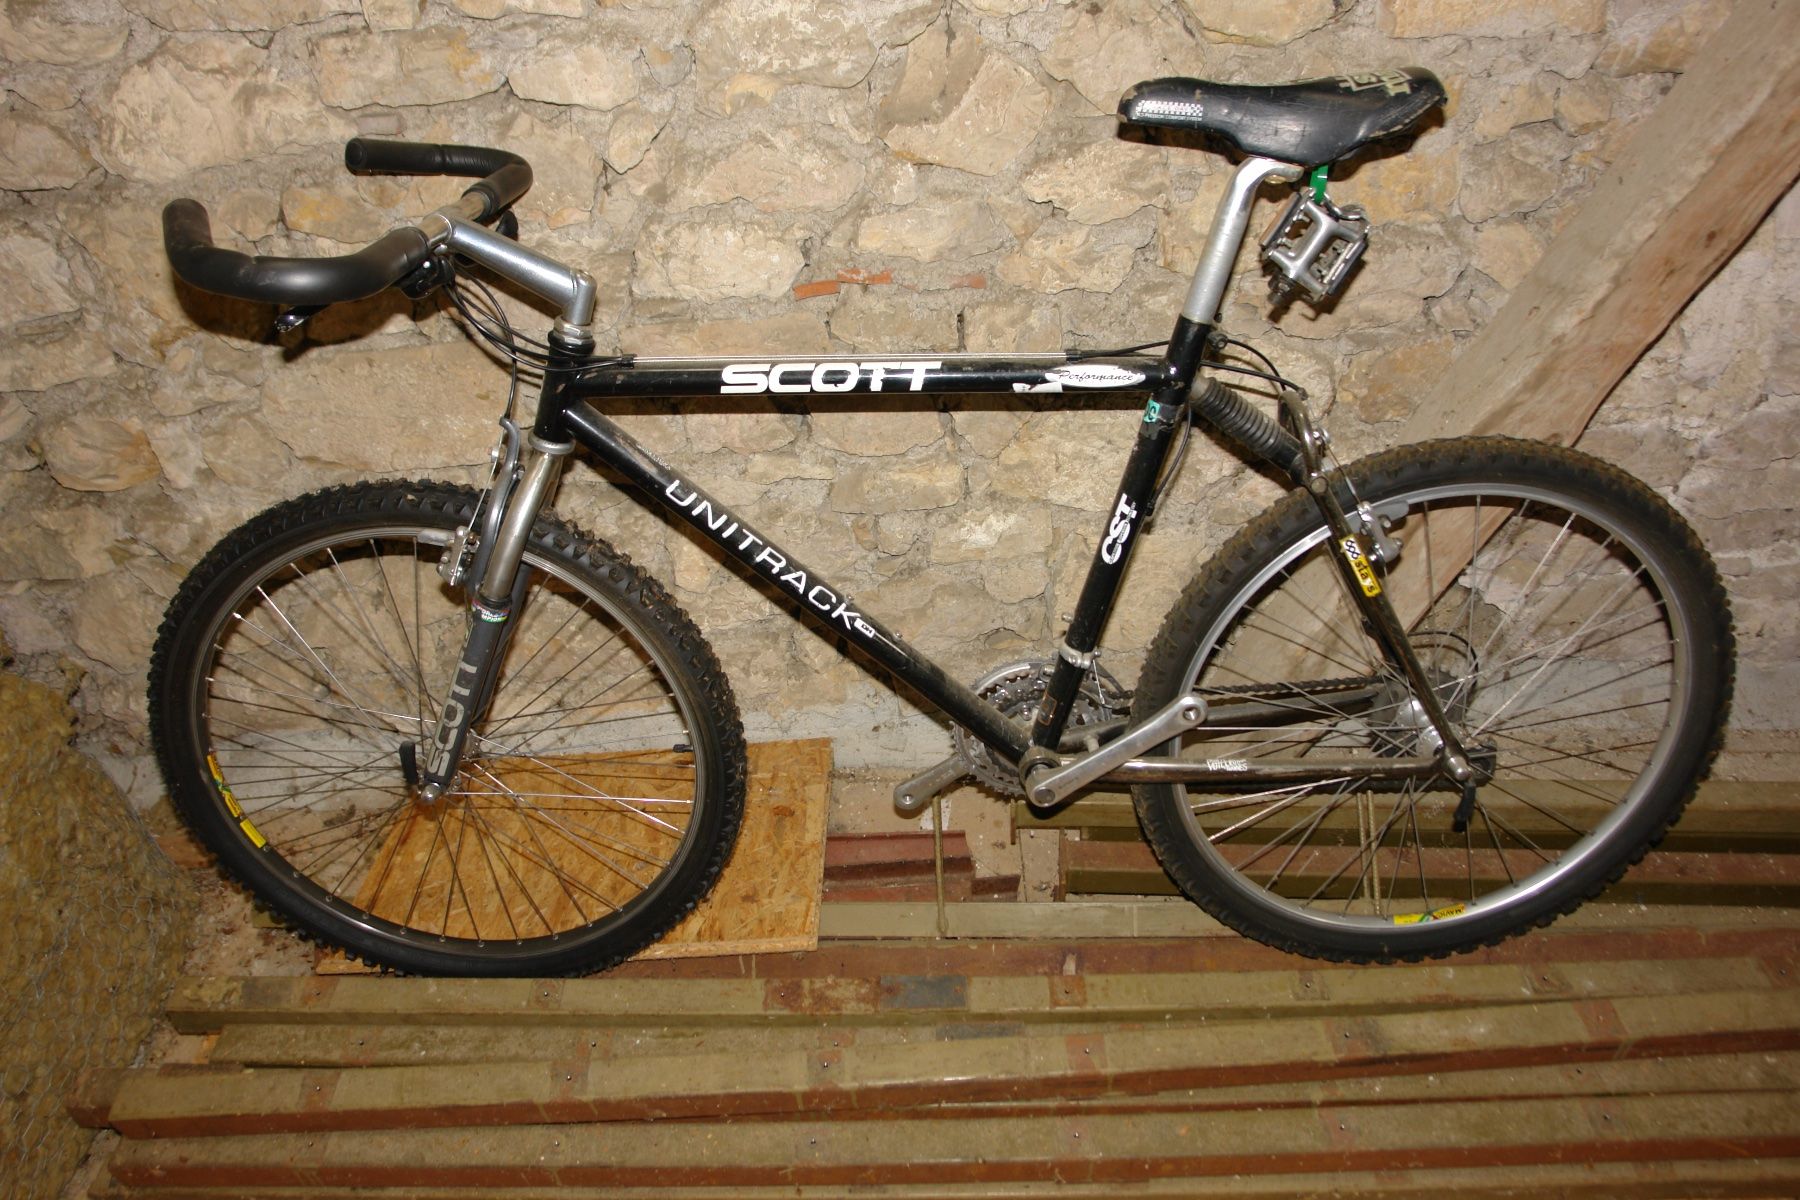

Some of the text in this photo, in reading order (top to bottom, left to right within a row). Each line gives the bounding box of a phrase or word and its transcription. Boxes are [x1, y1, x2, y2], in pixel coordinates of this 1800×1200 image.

[720, 360, 942, 394] SCOTT
[1058, 370, 1134, 382] Performance
[665, 479, 862, 630] UNITRACK
[427, 650, 478, 777] SCOTT
